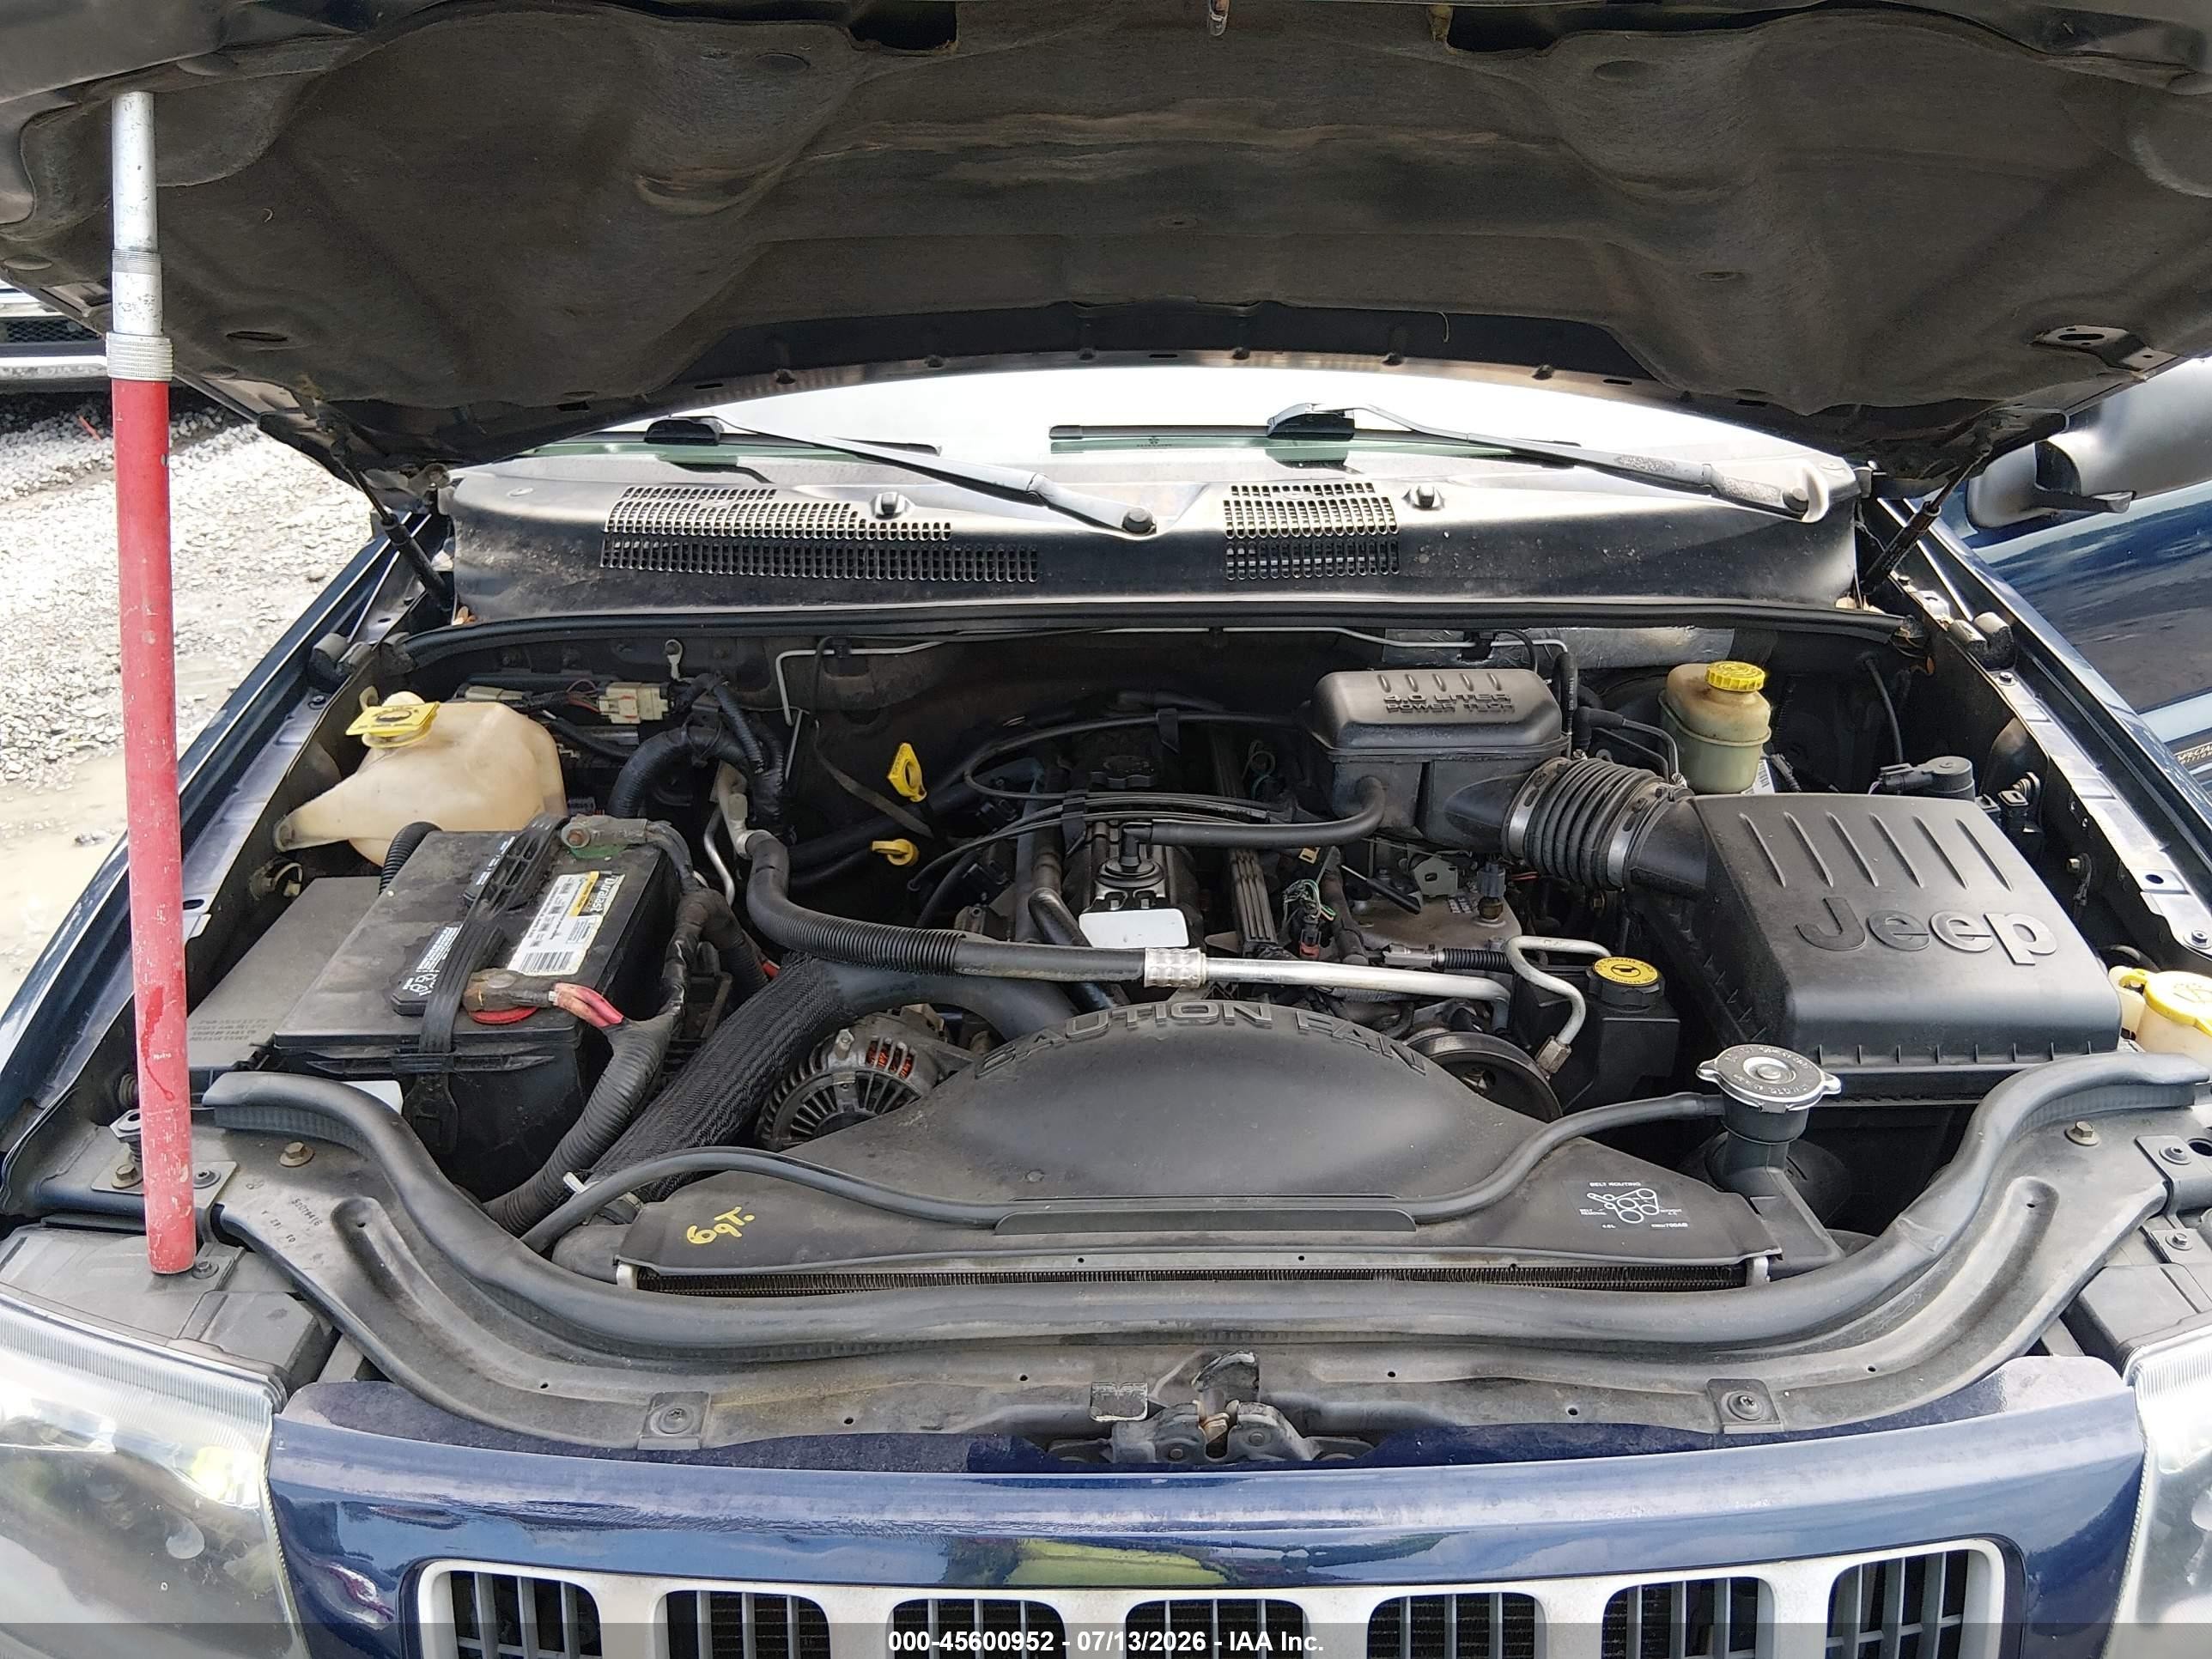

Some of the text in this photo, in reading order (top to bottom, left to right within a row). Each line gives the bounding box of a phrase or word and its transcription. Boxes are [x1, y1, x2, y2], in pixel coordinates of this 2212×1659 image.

[1383, 693, 1511, 703] 4.0 LITER
[1387, 703, 1515, 713] POWER TECH
[590, 873, 620, 913] Duralast
[1795, 897, 2057, 966] Jeep
[975, 1001, 1427, 1079] CAUTION FAN
